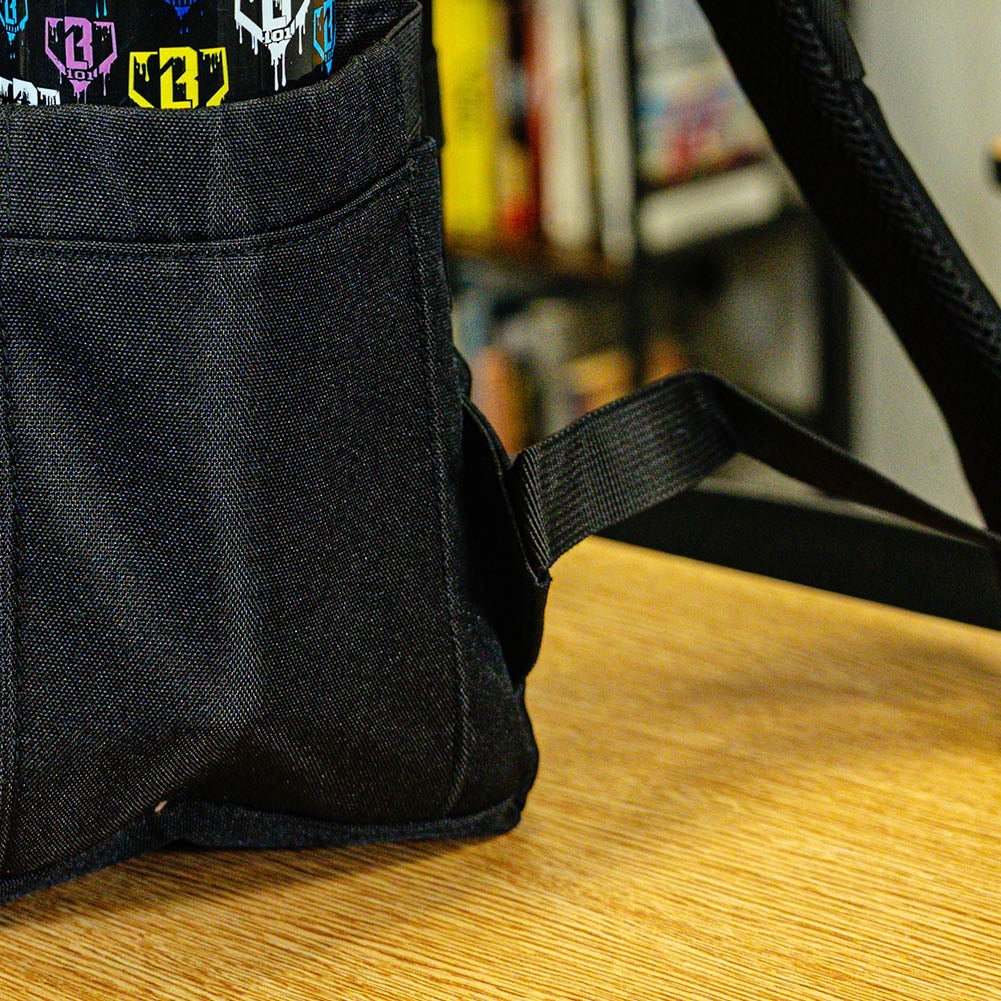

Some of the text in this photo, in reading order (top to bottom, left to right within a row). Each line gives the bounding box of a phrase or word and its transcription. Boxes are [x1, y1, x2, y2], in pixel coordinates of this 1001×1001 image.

[64, 16, 94, 69] B
[263, 26, 294, 45] 101
[66, 69, 94, 81] 101
[159, 46, 199, 110] B
